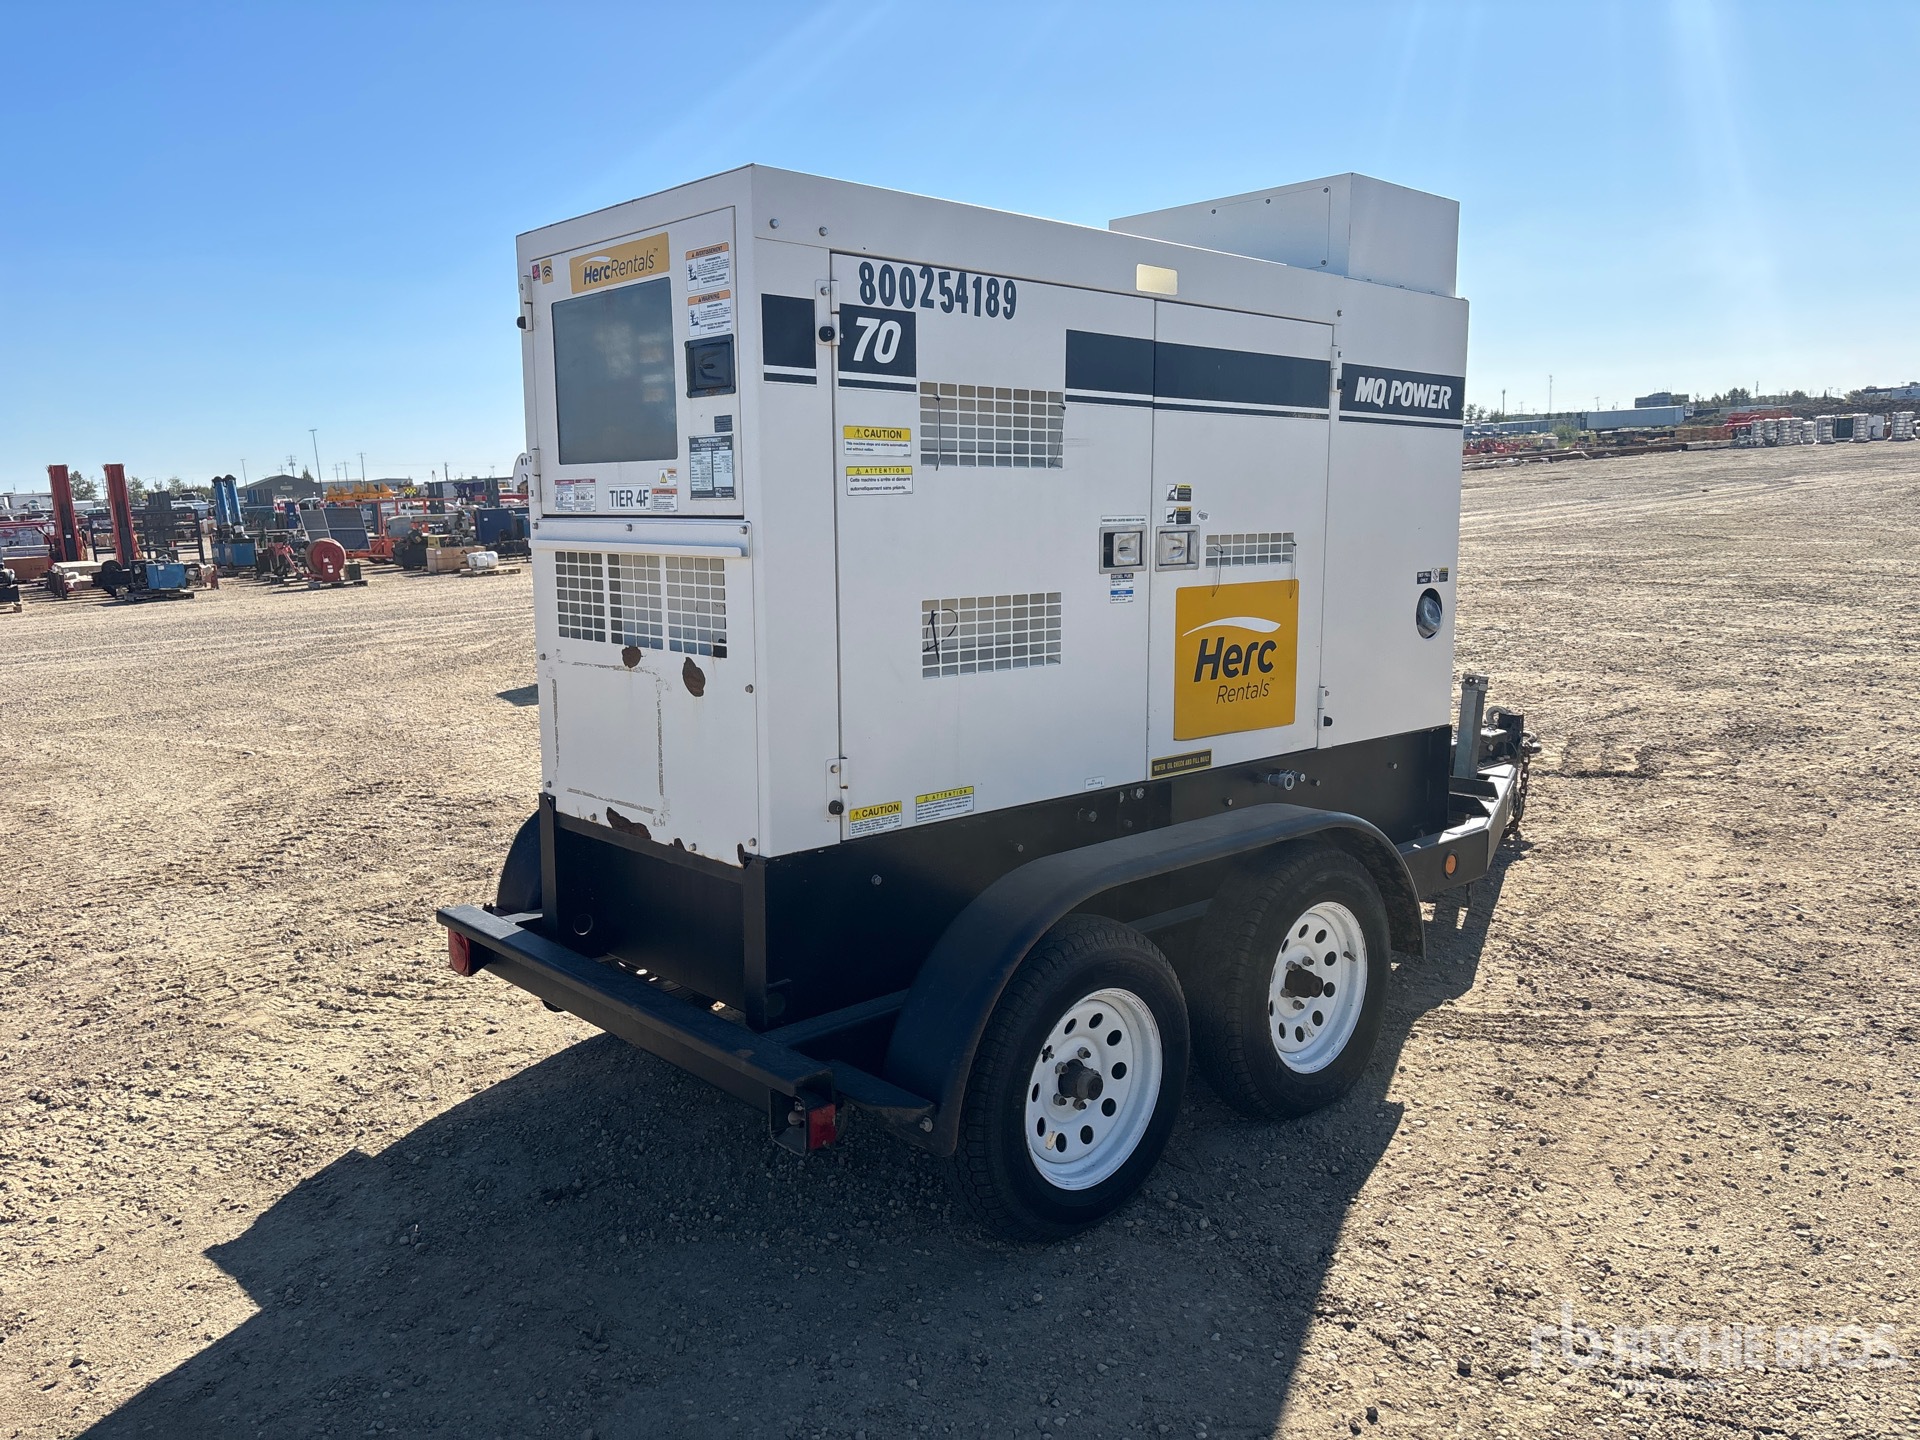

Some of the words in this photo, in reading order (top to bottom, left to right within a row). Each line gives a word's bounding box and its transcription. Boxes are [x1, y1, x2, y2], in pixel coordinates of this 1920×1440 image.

[858, 261, 1017, 320] 800254189
[853, 316, 902, 364] 70
[1354, 376, 1387, 409] MQ
[1388, 380, 1452, 410] POWER
[863, 428, 902, 439] CAUTION
[609, 490, 634, 508] TIER
[636, 489, 649, 507] 4F
[1194, 637, 1277, 682] Herc
[1216, 679, 1269, 704] Rentals
[1154, 763, 1165, 771] WATER
[1173, 760, 1185, 768] CHECK
[932, 789, 967, 800] ATTENTION
[862, 804, 899, 818] CAUTION
